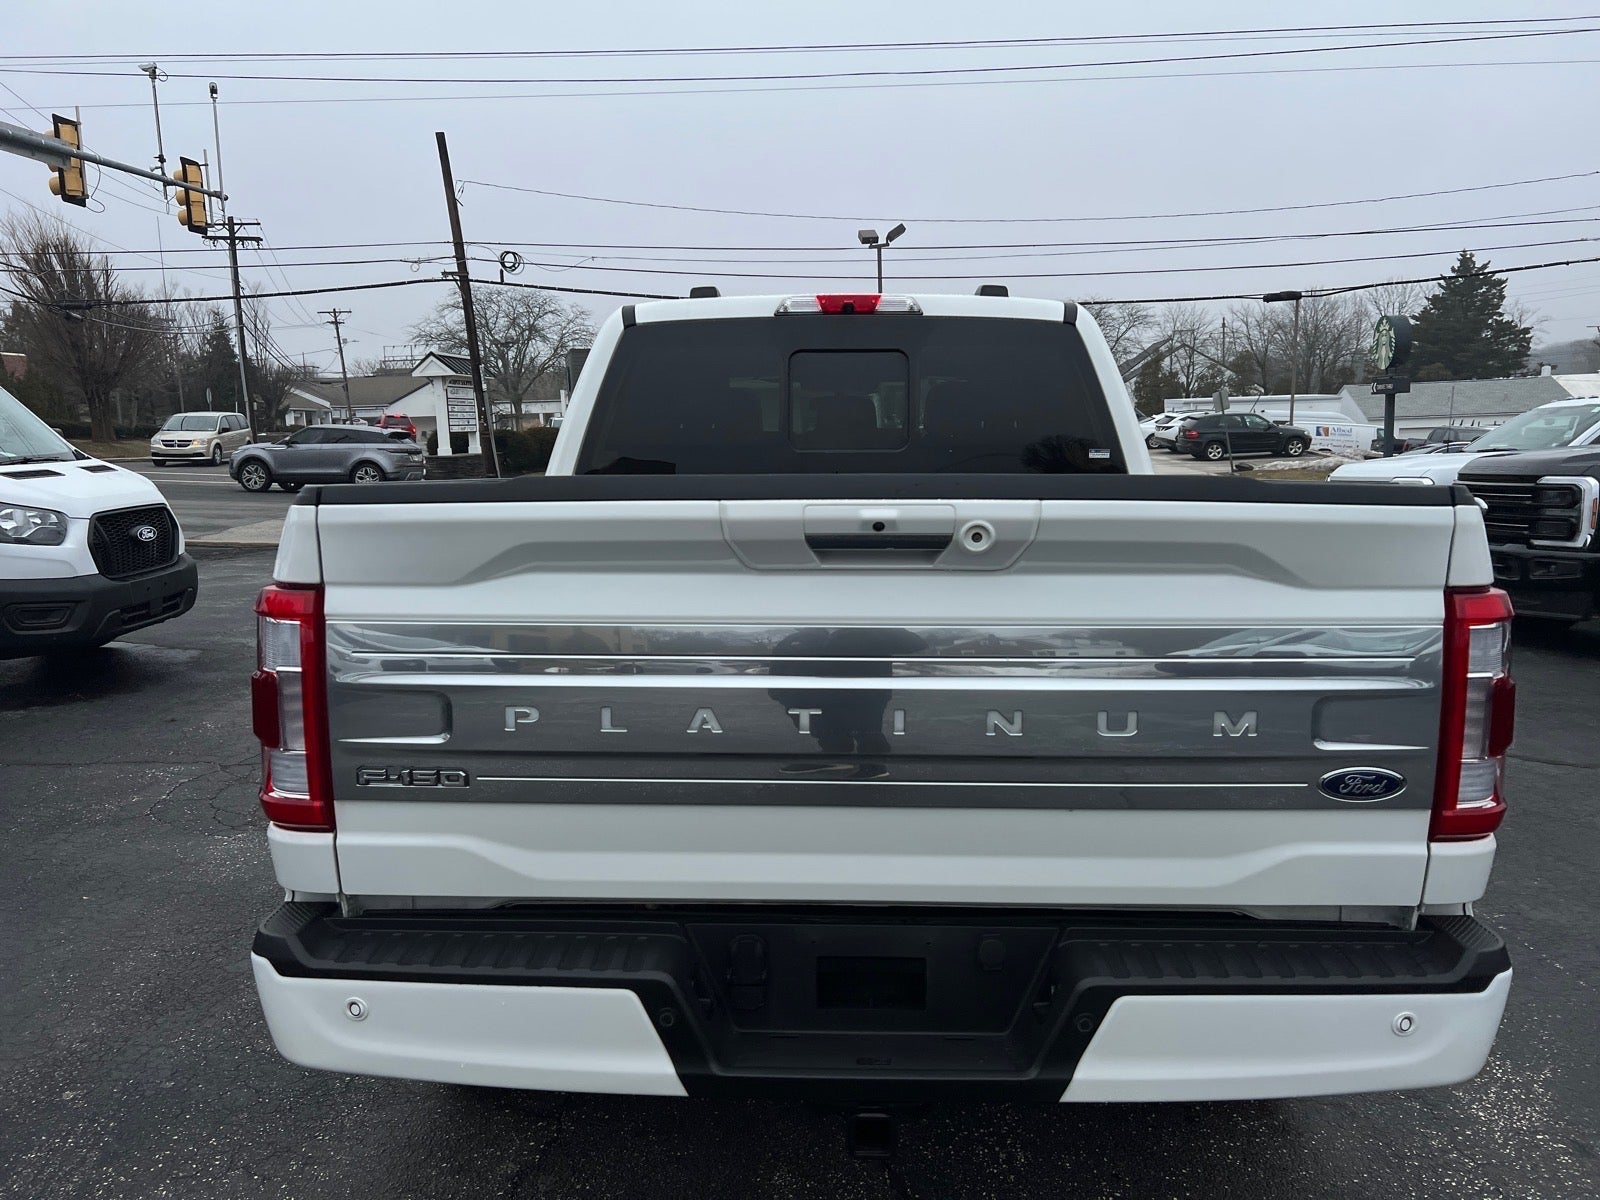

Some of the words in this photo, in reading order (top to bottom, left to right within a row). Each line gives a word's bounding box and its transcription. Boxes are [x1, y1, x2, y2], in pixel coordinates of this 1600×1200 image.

[504, 706, 1258, 737] PLATINUM
[356, 765, 470, 788] F-150
[1340, 774, 1388, 794] Ford
